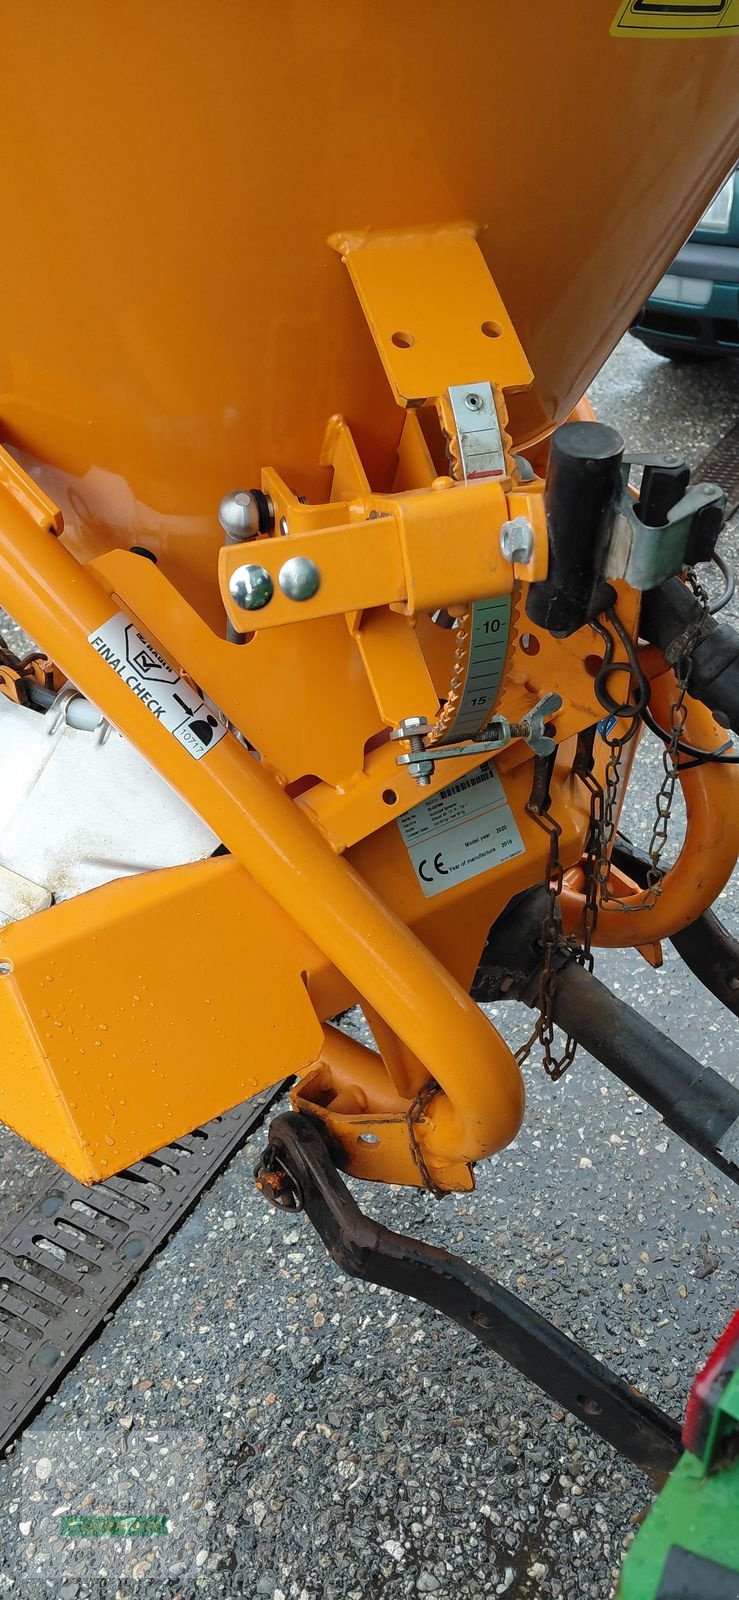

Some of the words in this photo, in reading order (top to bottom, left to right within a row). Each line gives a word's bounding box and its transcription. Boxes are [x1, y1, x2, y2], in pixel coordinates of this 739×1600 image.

[482, 619, 500, 634] 10
[90, 636, 127, 678] FINAL
[125, 675, 167, 719] CHECK
[471, 695, 487, 707] 15
[179, 728, 205, 753] 10717
[464, 836, 479, 848] Model
[480, 832, 490, 843] year
[496, 825, 507, 834] 2020
[418, 852, 449, 882] CE
[448, 864, 460, 873] Year
[467, 847, 496, 864] manufacture
